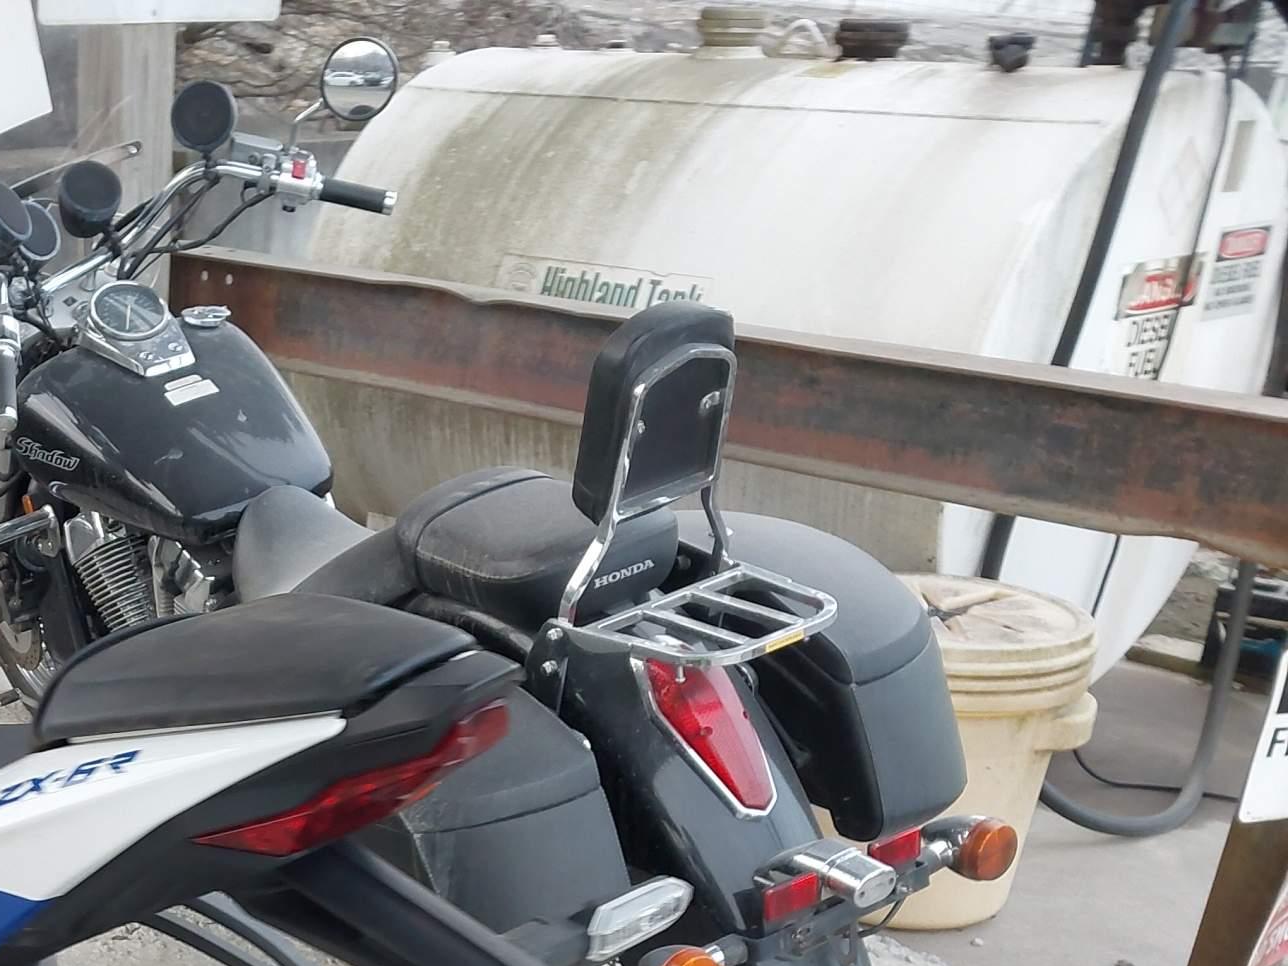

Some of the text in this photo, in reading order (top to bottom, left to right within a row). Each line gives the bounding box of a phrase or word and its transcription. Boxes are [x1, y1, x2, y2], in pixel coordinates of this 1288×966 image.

[540, 265, 643, 308] Highland
[1127, 313, 1172, 347] DIESE
[15, 436, 81, 472] Shadow
[593, 559, 655, 589] HONDA
